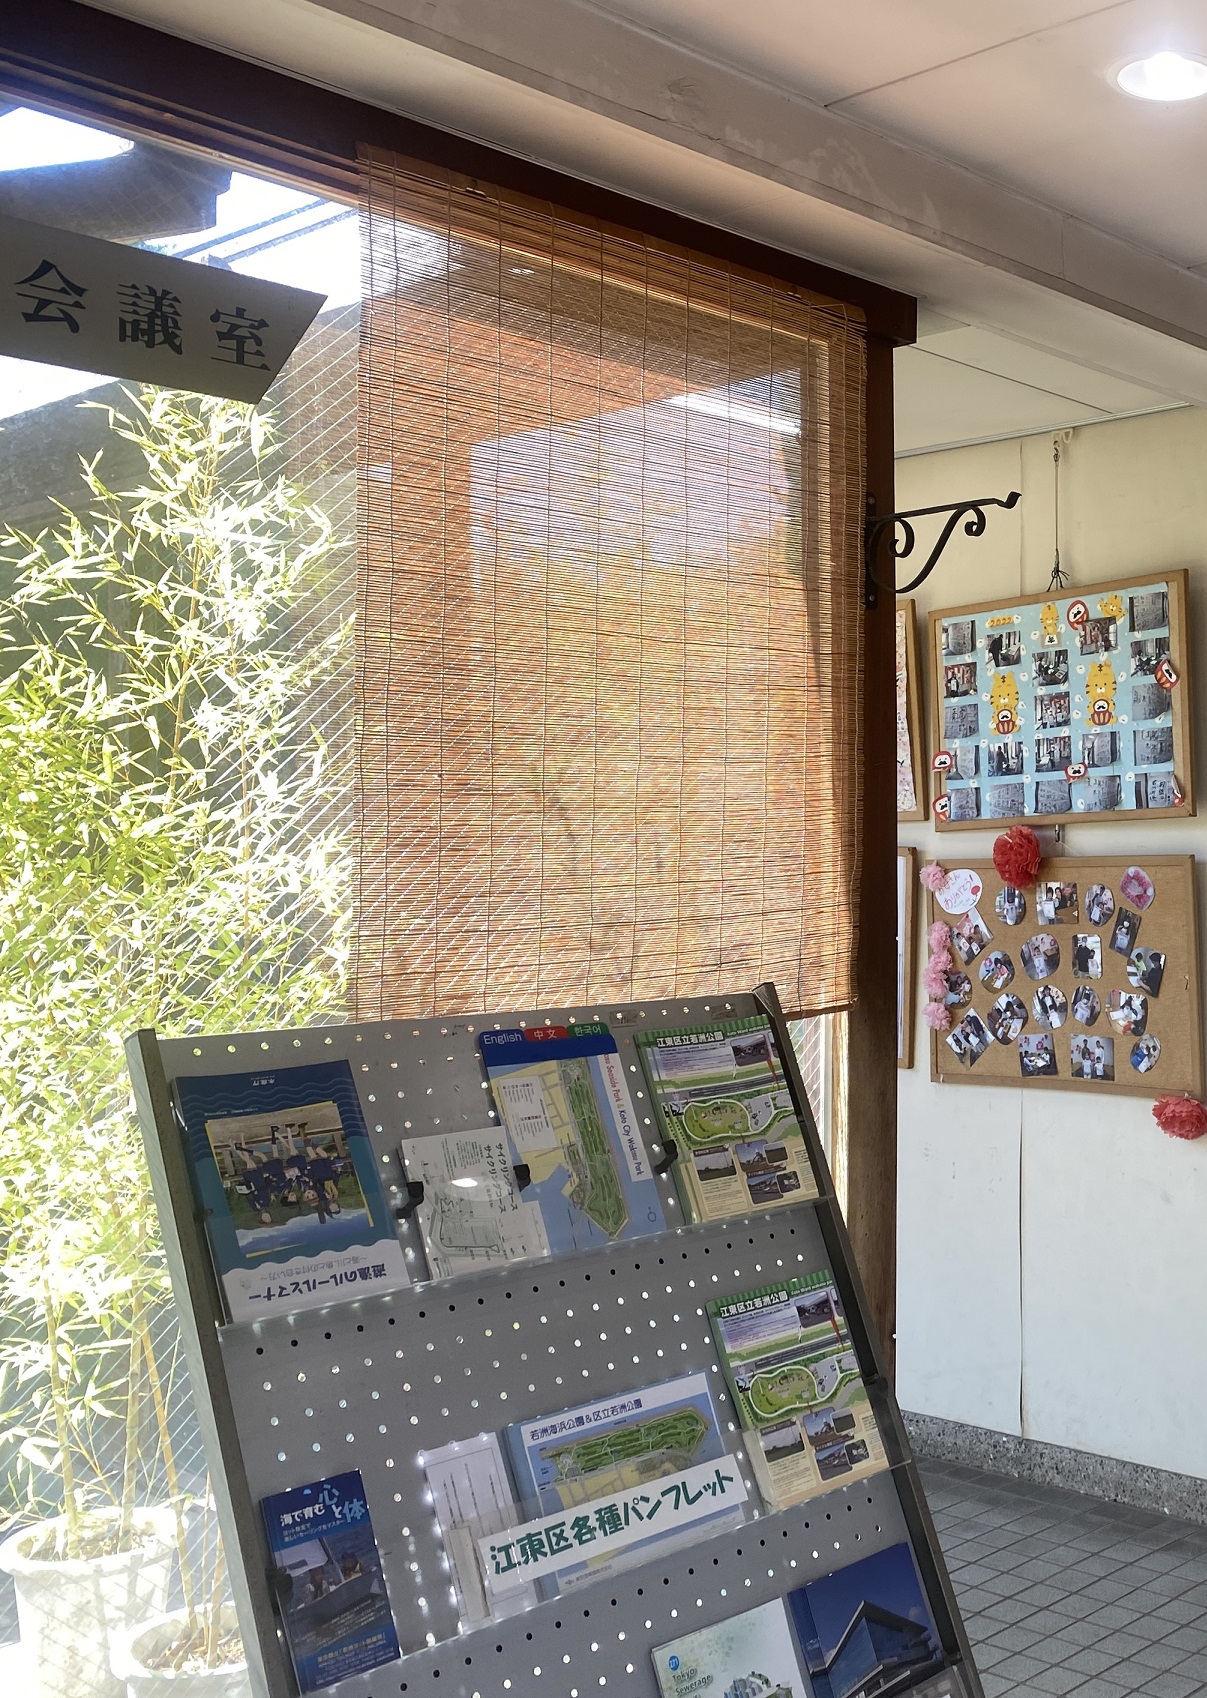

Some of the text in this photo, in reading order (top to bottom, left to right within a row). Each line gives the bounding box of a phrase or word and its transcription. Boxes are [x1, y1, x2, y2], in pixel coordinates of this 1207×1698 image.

[13, 258, 272, 372] 会議室
[989, 617, 1013, 628] 2022
[483, 1032, 522, 1045] English
[533, 1029, 558, 1040] 中文
[574, 1024, 602, 1037] 한국어
[607, 1065, 618, 1088] Seaside
[613, 1089, 622, 1102] Park
[619, 1110, 628, 1124] Koto
[634, 1161, 644, 1176] Park
[248, 1262, 387, 1302] 遊漁のルールとマナー
[719, 1290, 788, 1317] 江東区立若洲公園
[490, 1469, 734, 1575] 江東区各種パンフレット
[672, 1668, 697, 1683] Tokyo
[675, 1674, 713, 1696] Sewerage
